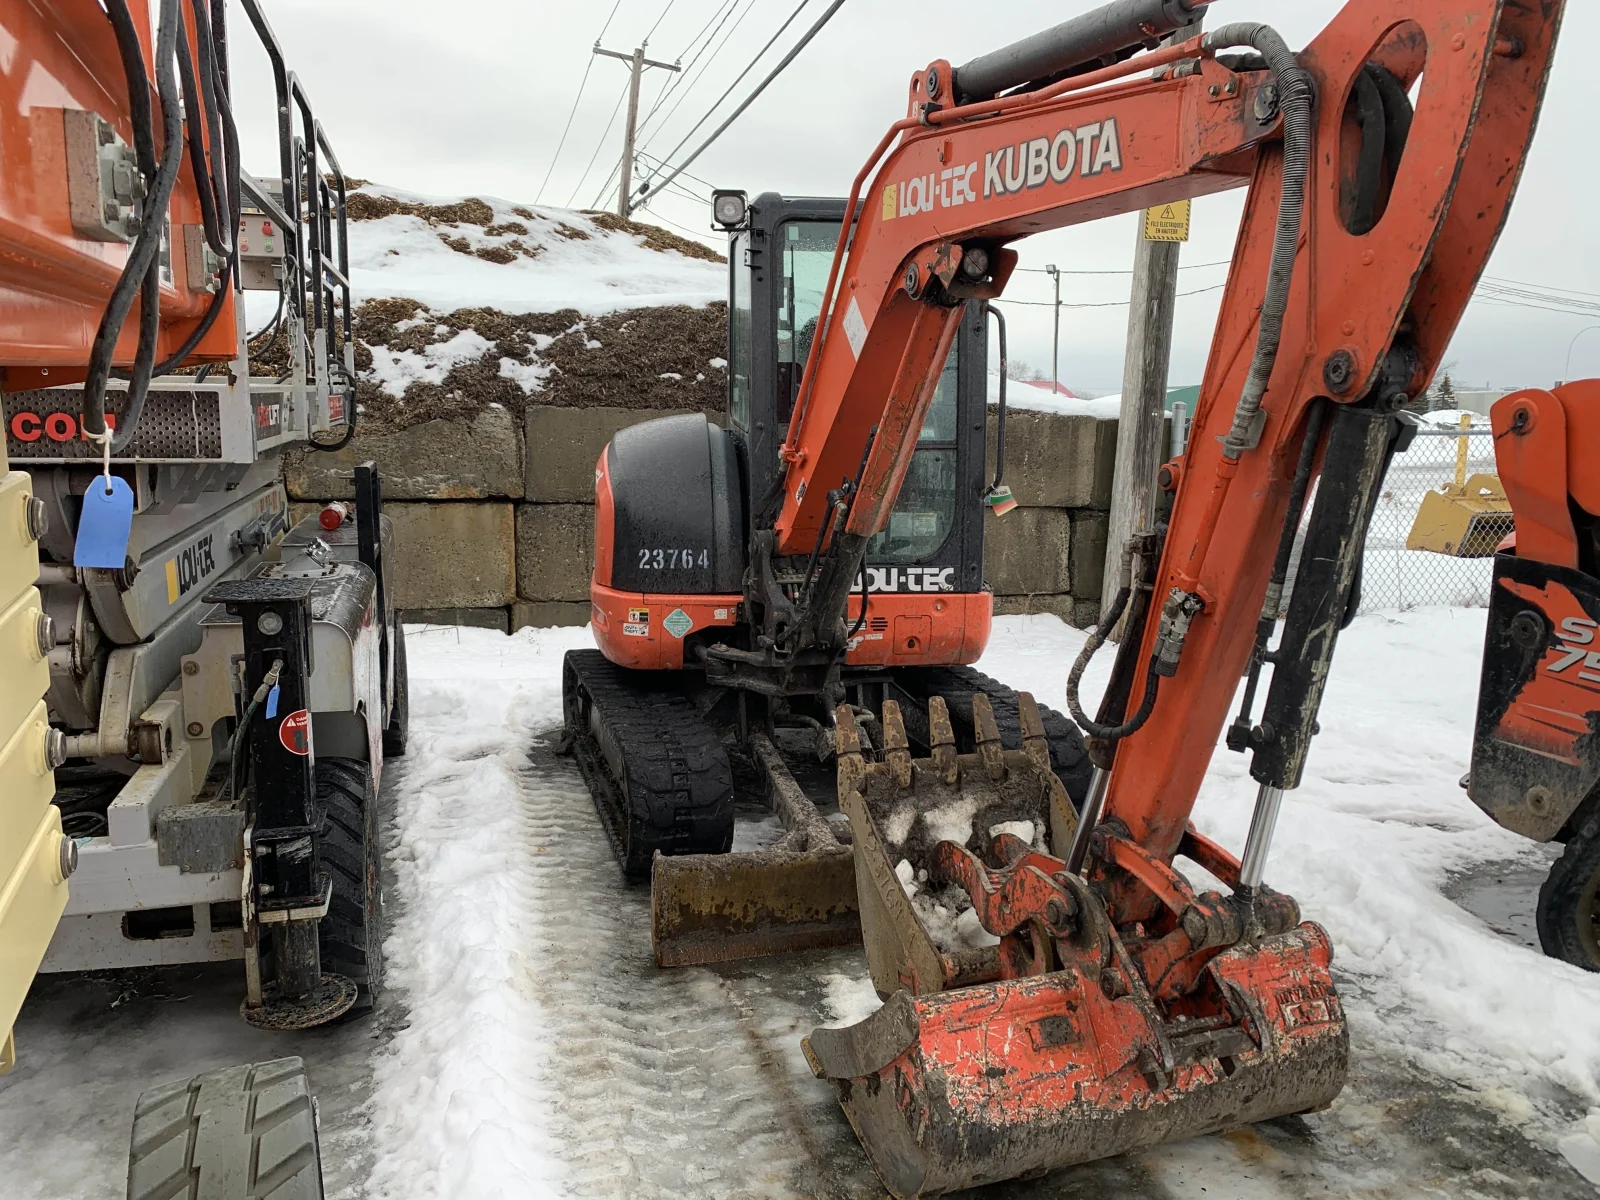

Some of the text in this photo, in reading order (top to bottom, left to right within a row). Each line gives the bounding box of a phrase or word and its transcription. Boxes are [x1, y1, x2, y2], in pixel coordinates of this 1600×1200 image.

[983, 118, 1121, 199] KUBOTA
[899, 161, 978, 218] LOU-TEC
[176, 533, 215, 596] LOU-TEC
[638, 548, 709, 570] 23764
